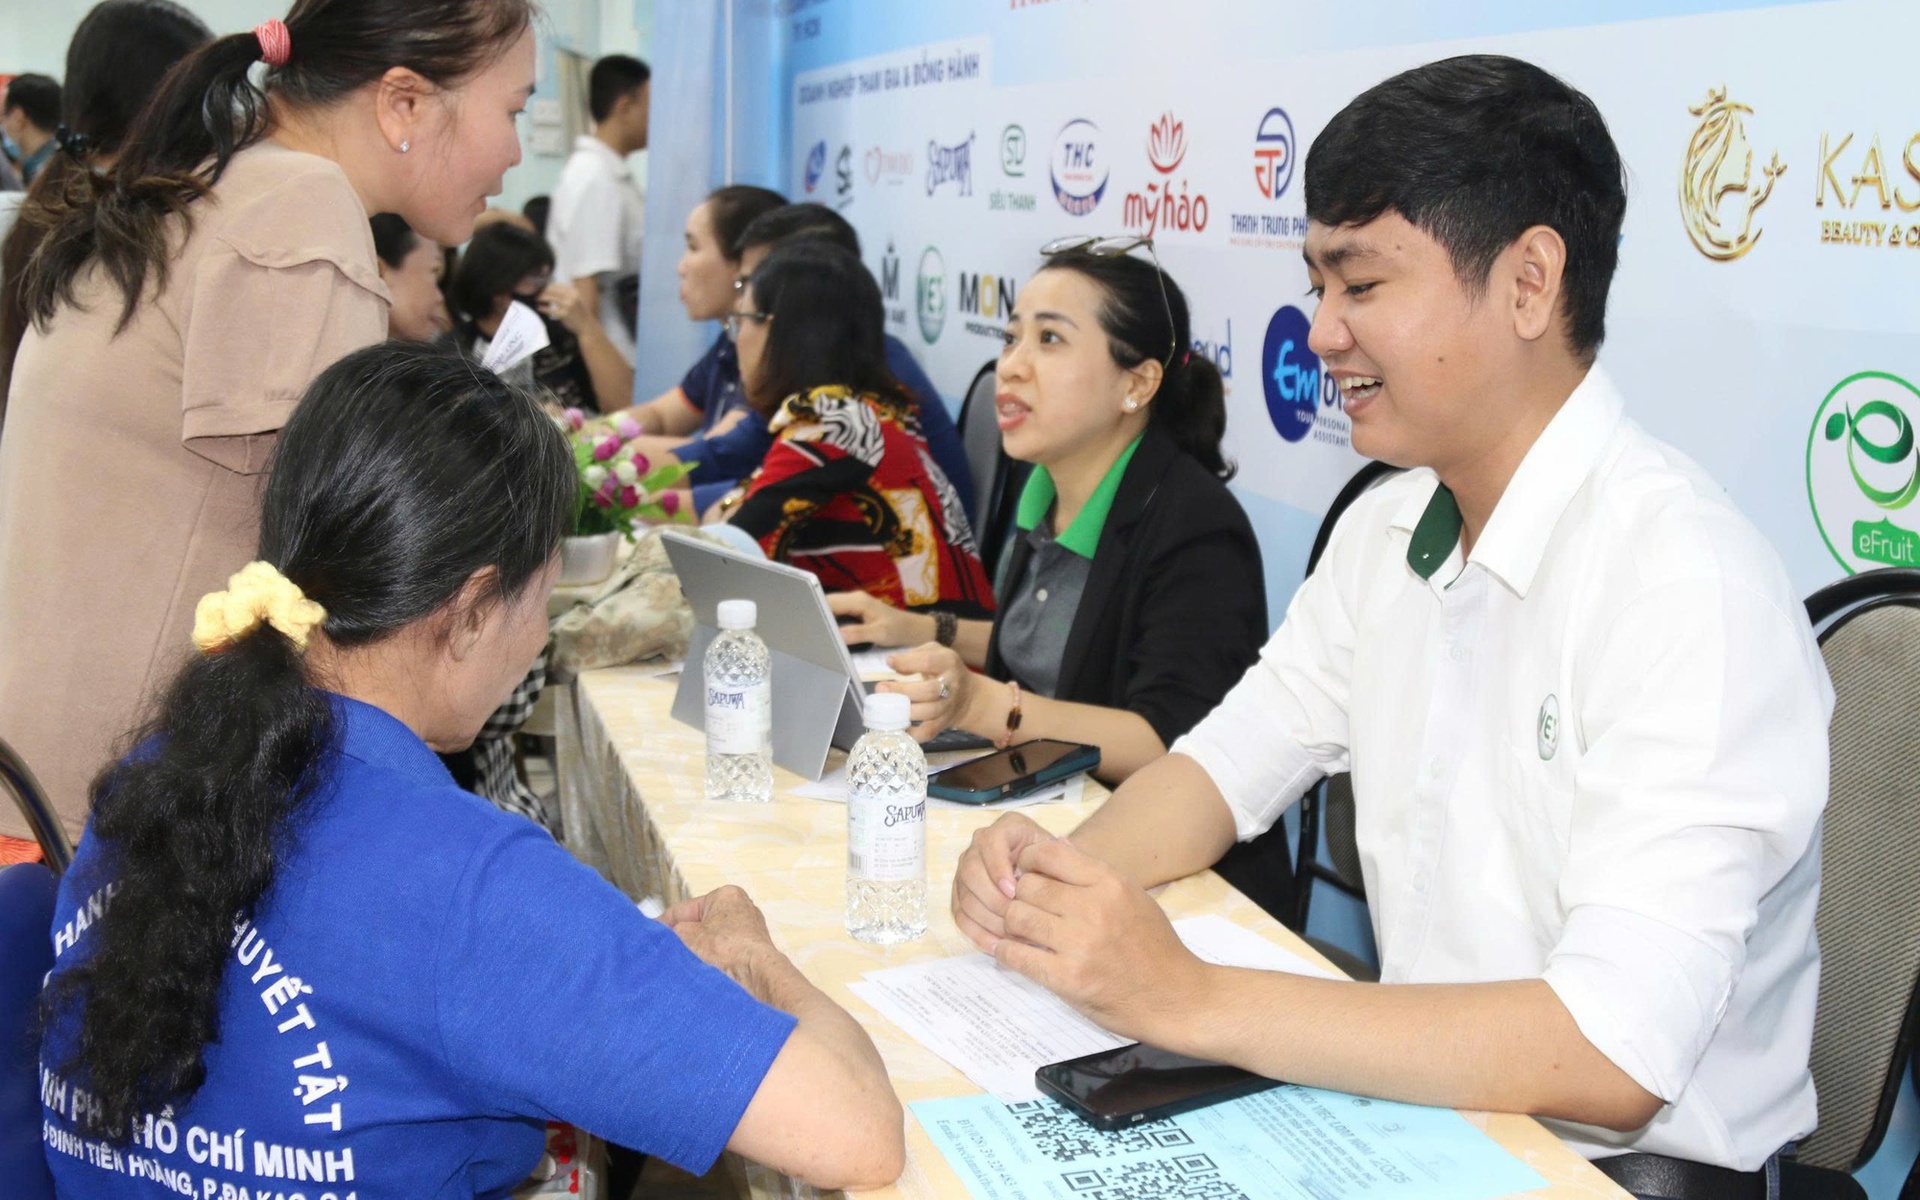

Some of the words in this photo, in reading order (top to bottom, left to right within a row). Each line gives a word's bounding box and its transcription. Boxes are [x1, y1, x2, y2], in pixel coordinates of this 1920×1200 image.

[1064, 142, 1095, 168] THC
[1231, 214, 1259, 235] THANH
[1261, 215, 1290, 237] TRUNG
[1821, 220, 1887, 245] BEAUTY
[1888, 224, 1903, 247] &
[959, 271, 1014, 321] MON
[1316, 414, 1350, 433] PERSONAL
[1313, 430, 1350, 449] ASSISTANT
[1859, 530, 1914, 564] eFruit
[231, 909, 317, 1034] HUYẾT
[293, 1041, 349, 1131] TẬT
[186, 1126, 245, 1173] CHÍ
[254, 1141, 354, 1183] MINH
